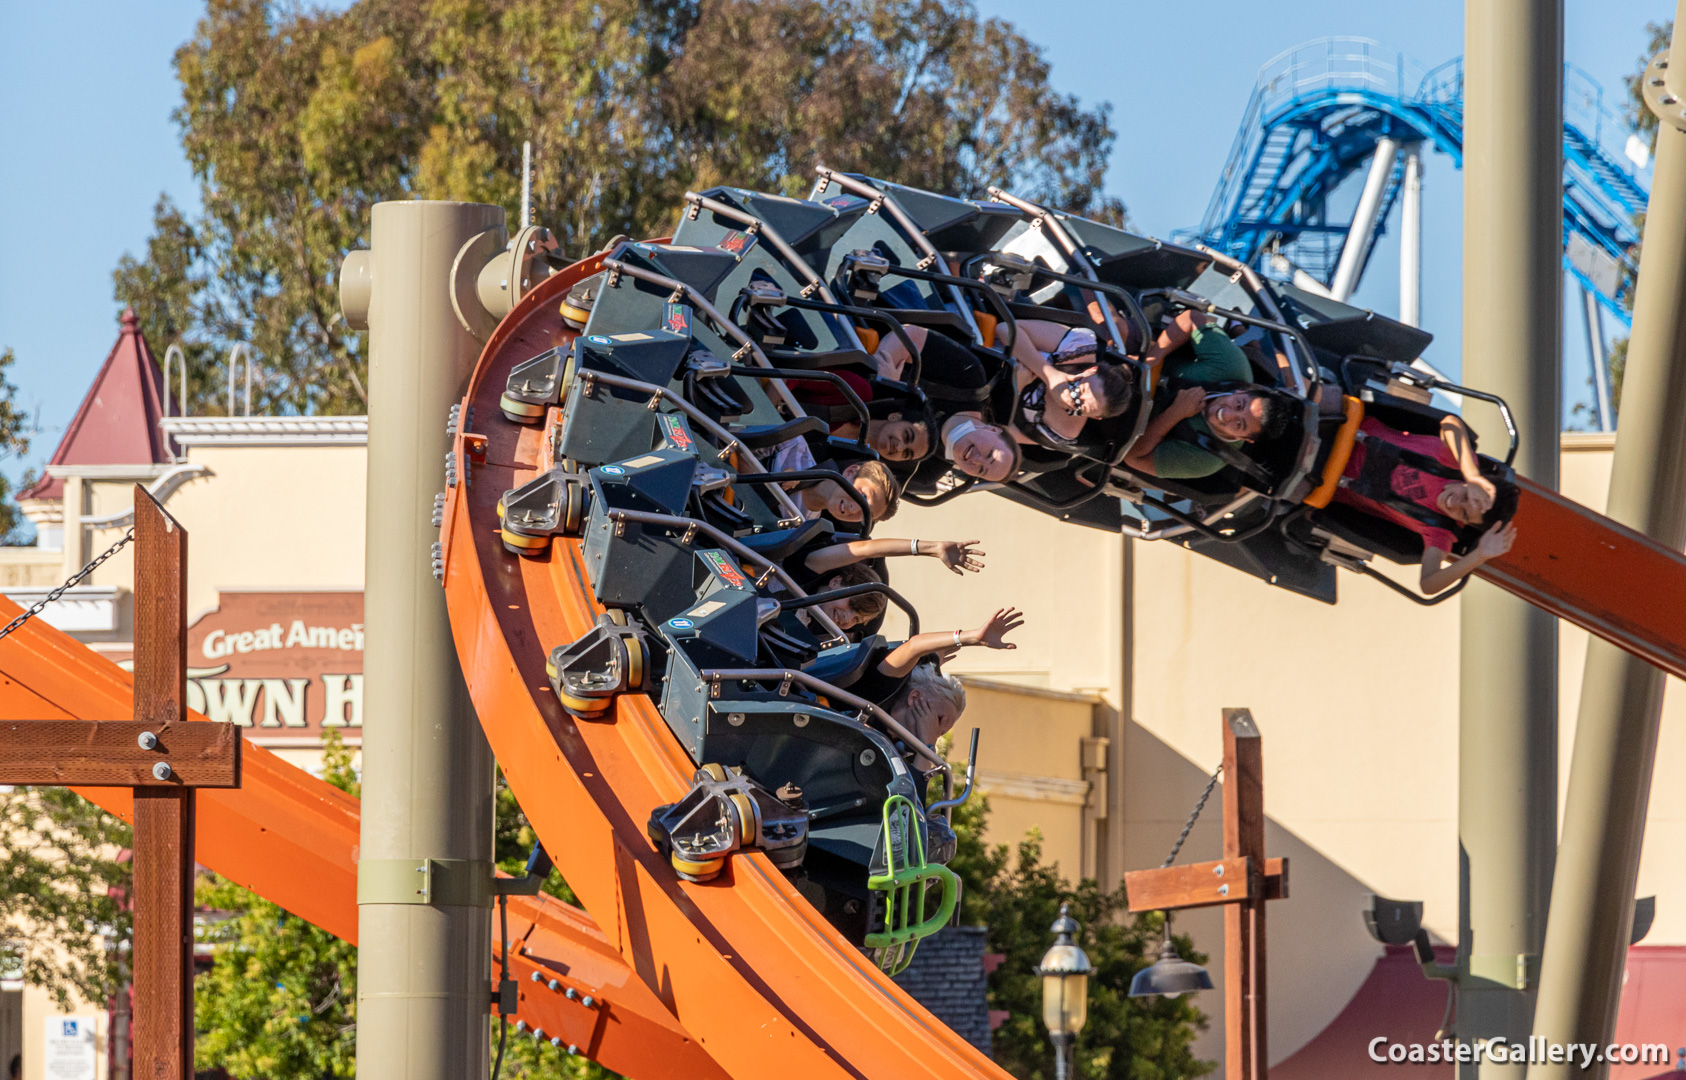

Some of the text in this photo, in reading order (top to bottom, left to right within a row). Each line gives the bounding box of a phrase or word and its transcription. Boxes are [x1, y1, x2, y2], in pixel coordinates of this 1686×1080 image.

[202, 620, 364, 659] Great Amer
[187, 664, 311, 728] WN
